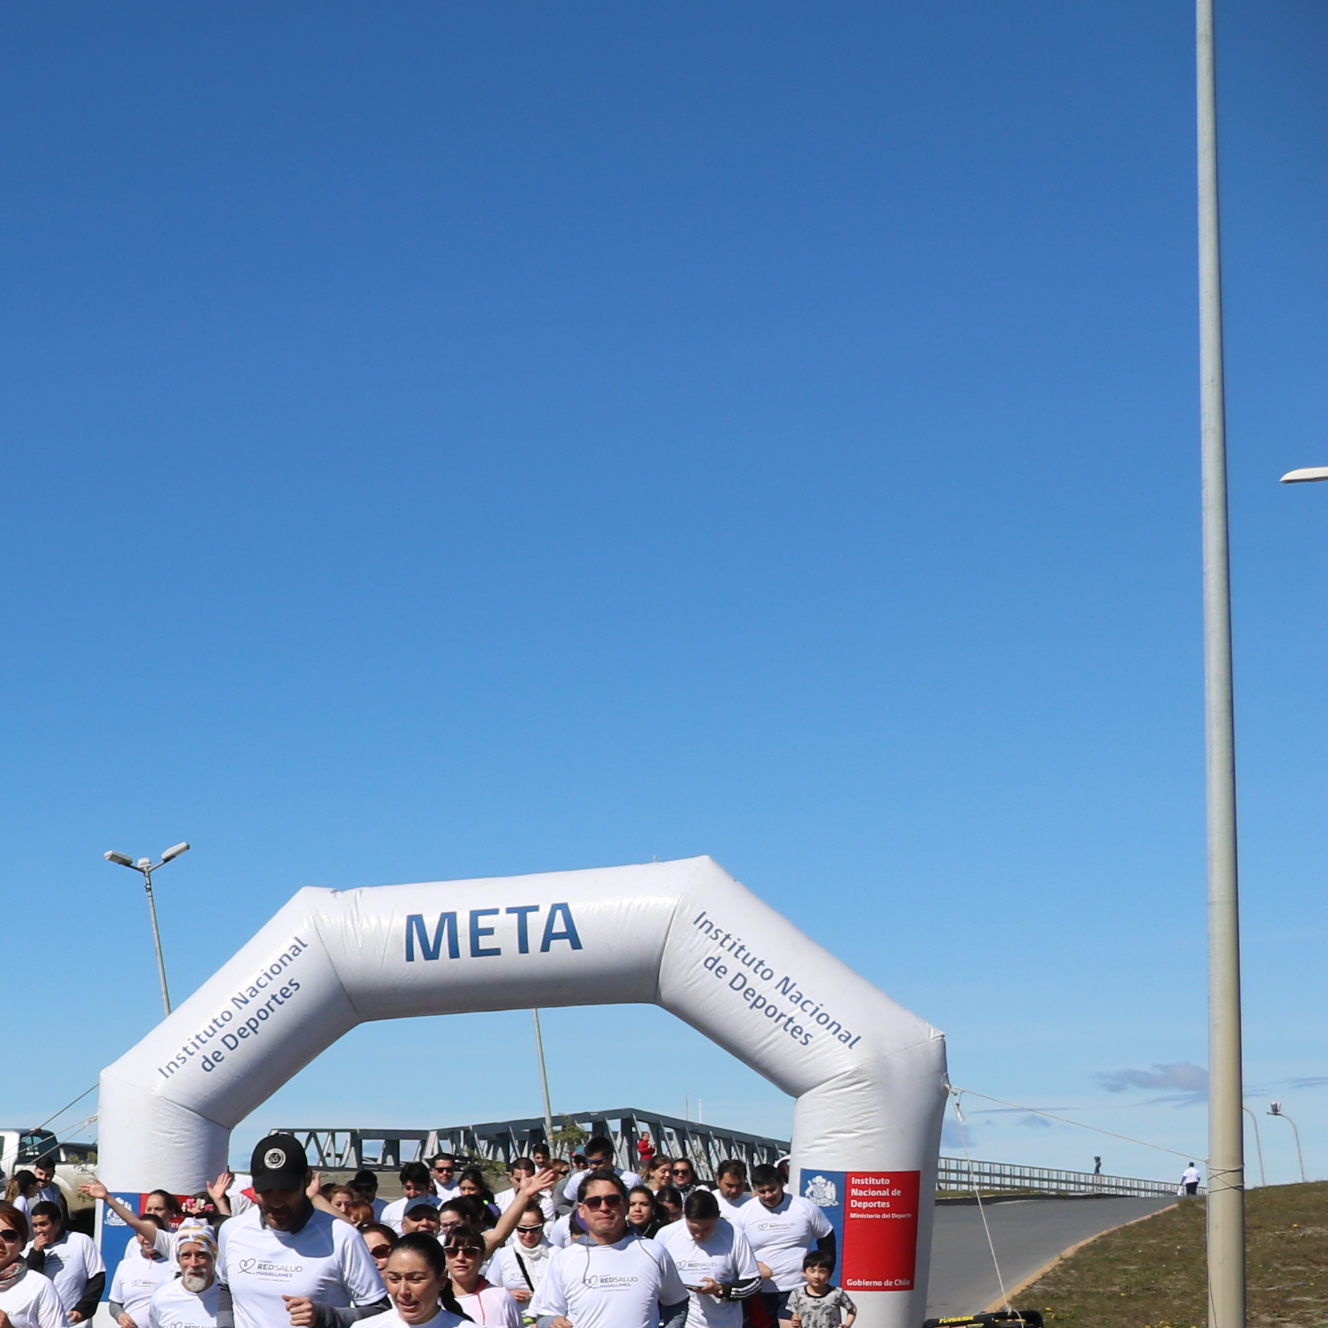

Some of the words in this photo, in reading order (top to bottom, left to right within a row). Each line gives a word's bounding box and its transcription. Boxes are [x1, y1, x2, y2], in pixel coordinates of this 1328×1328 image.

[406, 902, 583, 962] META
[157, 1010, 233, 1079] Instituto
[230, 936, 308, 1010] Nacional
[693, 911, 774, 981] Instituto
[774, 976, 862, 1050] Nacional
[703, 955, 728, 979] de
[728, 972, 813, 1046] Deportes
[200, 1050, 225, 1072] de
[220, 978, 300, 1051] Deportes
[850, 1188, 889, 1197] Nacional
[891, 1188, 901, 1196] de
[850, 1200, 890, 1209] Deportes
[851, 1177, 890, 1185] Instituto
[257, 1263, 303, 1273] REDSALUD
